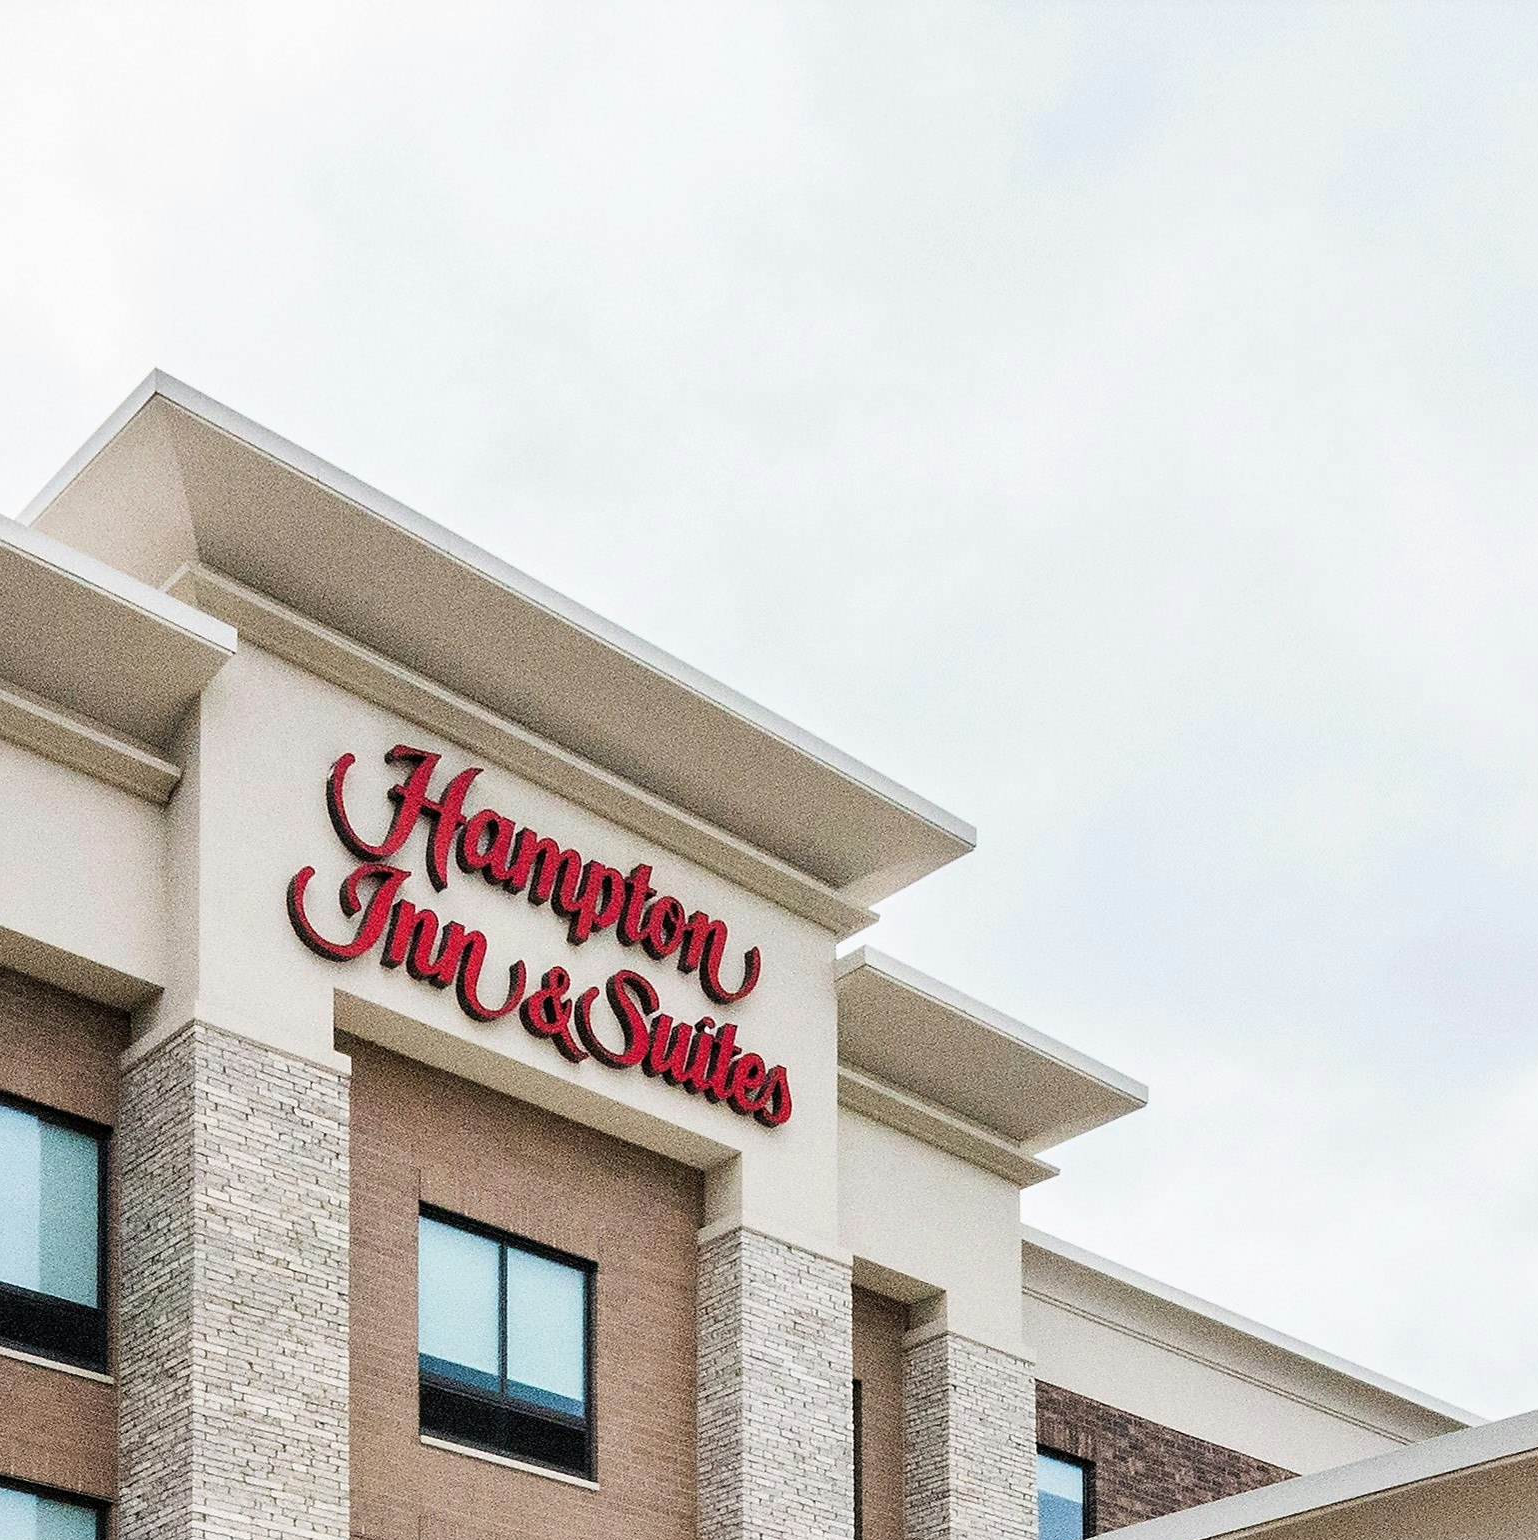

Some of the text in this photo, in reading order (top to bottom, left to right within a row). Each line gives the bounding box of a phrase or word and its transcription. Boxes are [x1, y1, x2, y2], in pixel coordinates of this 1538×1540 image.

[287, 863, 794, 1128] Inn & Suites
[326, 744, 762, 1004] Hampton
